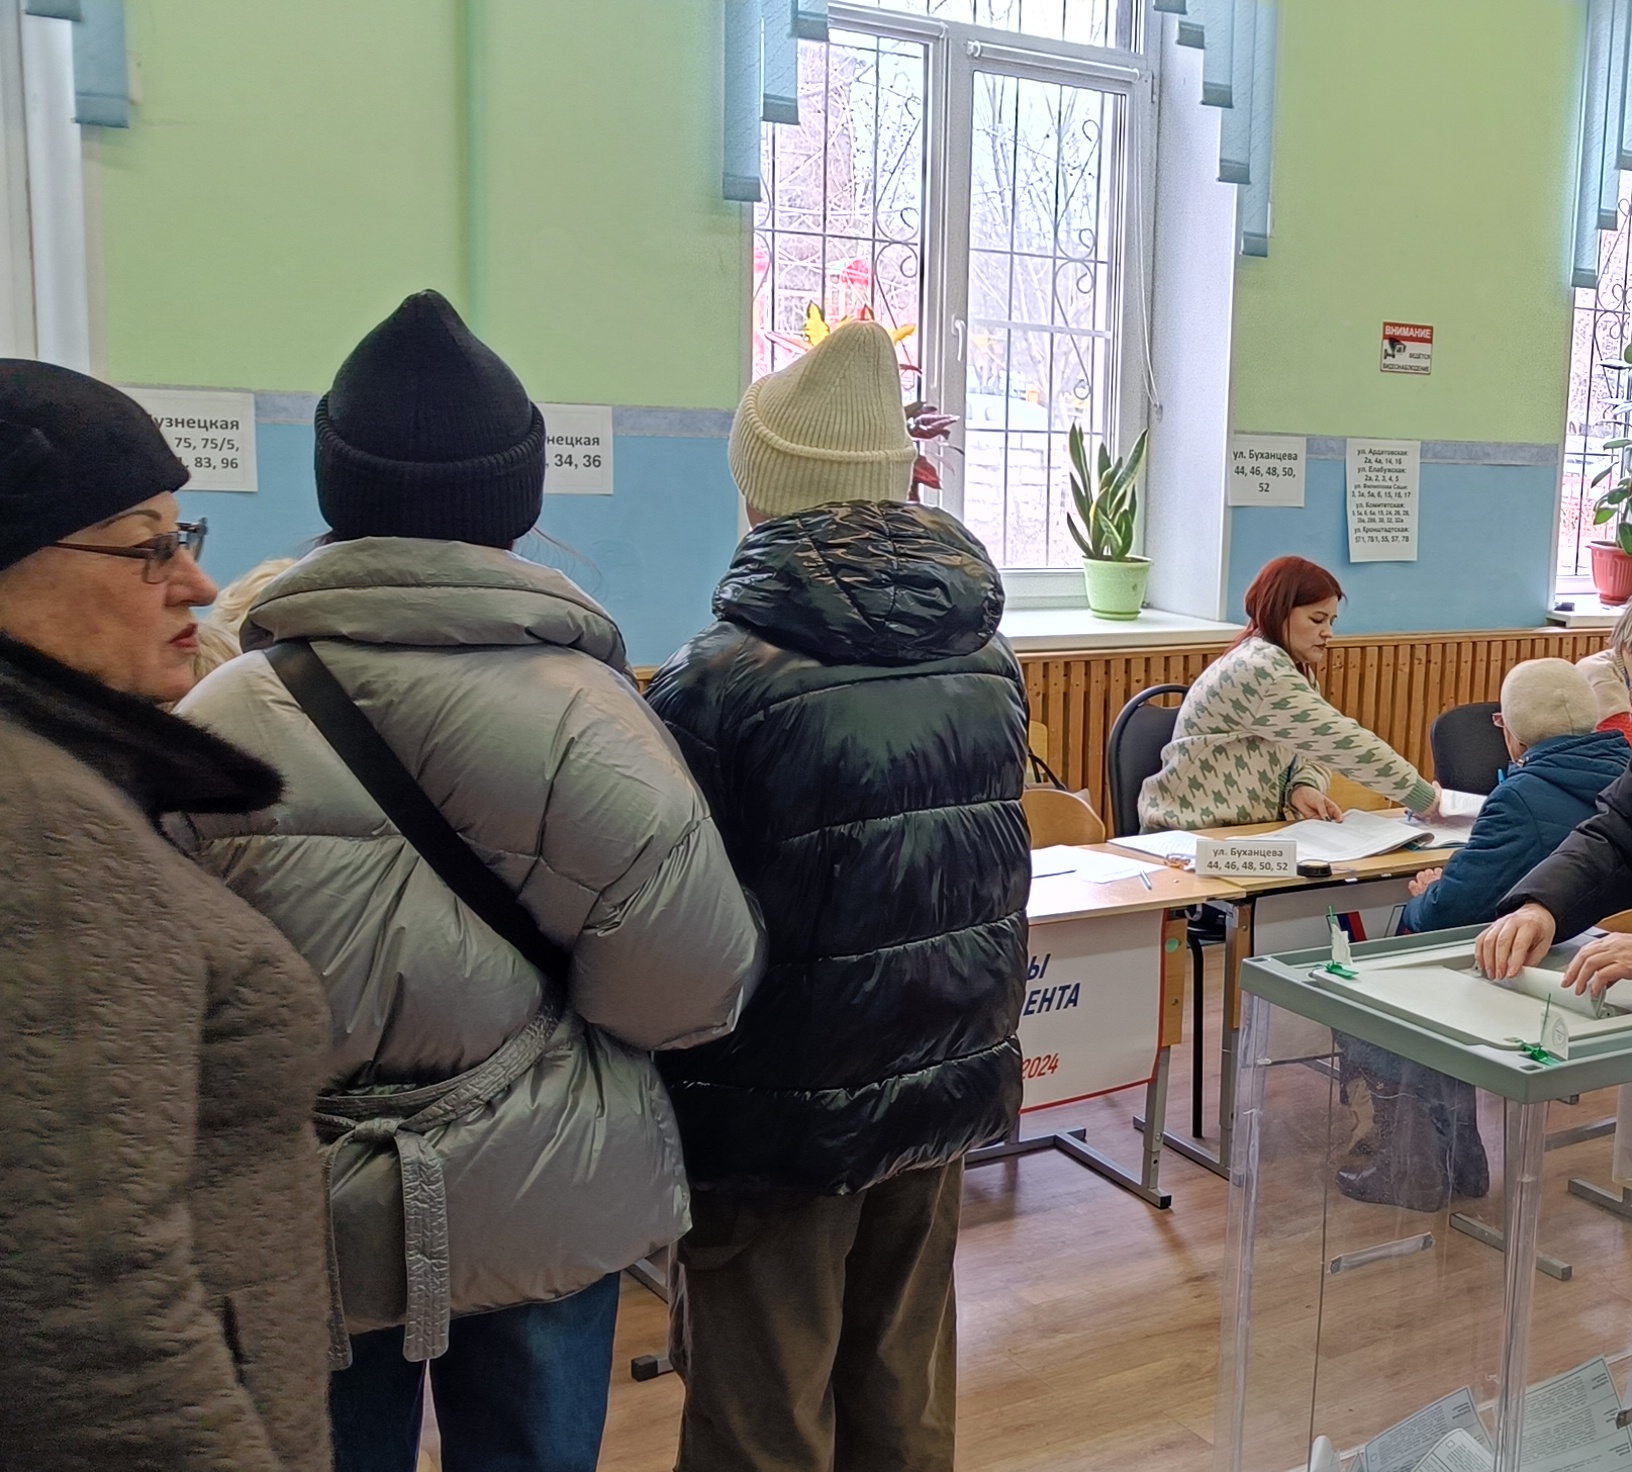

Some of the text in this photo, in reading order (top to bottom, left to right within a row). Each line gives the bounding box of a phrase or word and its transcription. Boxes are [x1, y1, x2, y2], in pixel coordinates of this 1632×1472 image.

[1384, 325, 1432, 339] ВНИМАНИЕ
[149, 414, 240, 432] узнецкая
[174, 437, 240, 452] 75, 75/5,
[546, 435, 600, 448] нецкая
[554, 453, 602, 470] 34, 36
[1233, 449, 1298, 462] ул. Буханцева
[194, 457, 217, 470] 83,
[220, 458, 239, 469] 96
[1234, 466, 1296, 478] 44, 46, 48, 50,
[1258, 482, 1270, 493] 52
[1212, 847, 1283, 858] ул. Буханцева
[1207, 860, 1288, 871] 44, 46, 48, 50, 52
[1023, 982, 1081, 1016] ЕНТА
[1022, 1053, 1059, 1080] 2024
